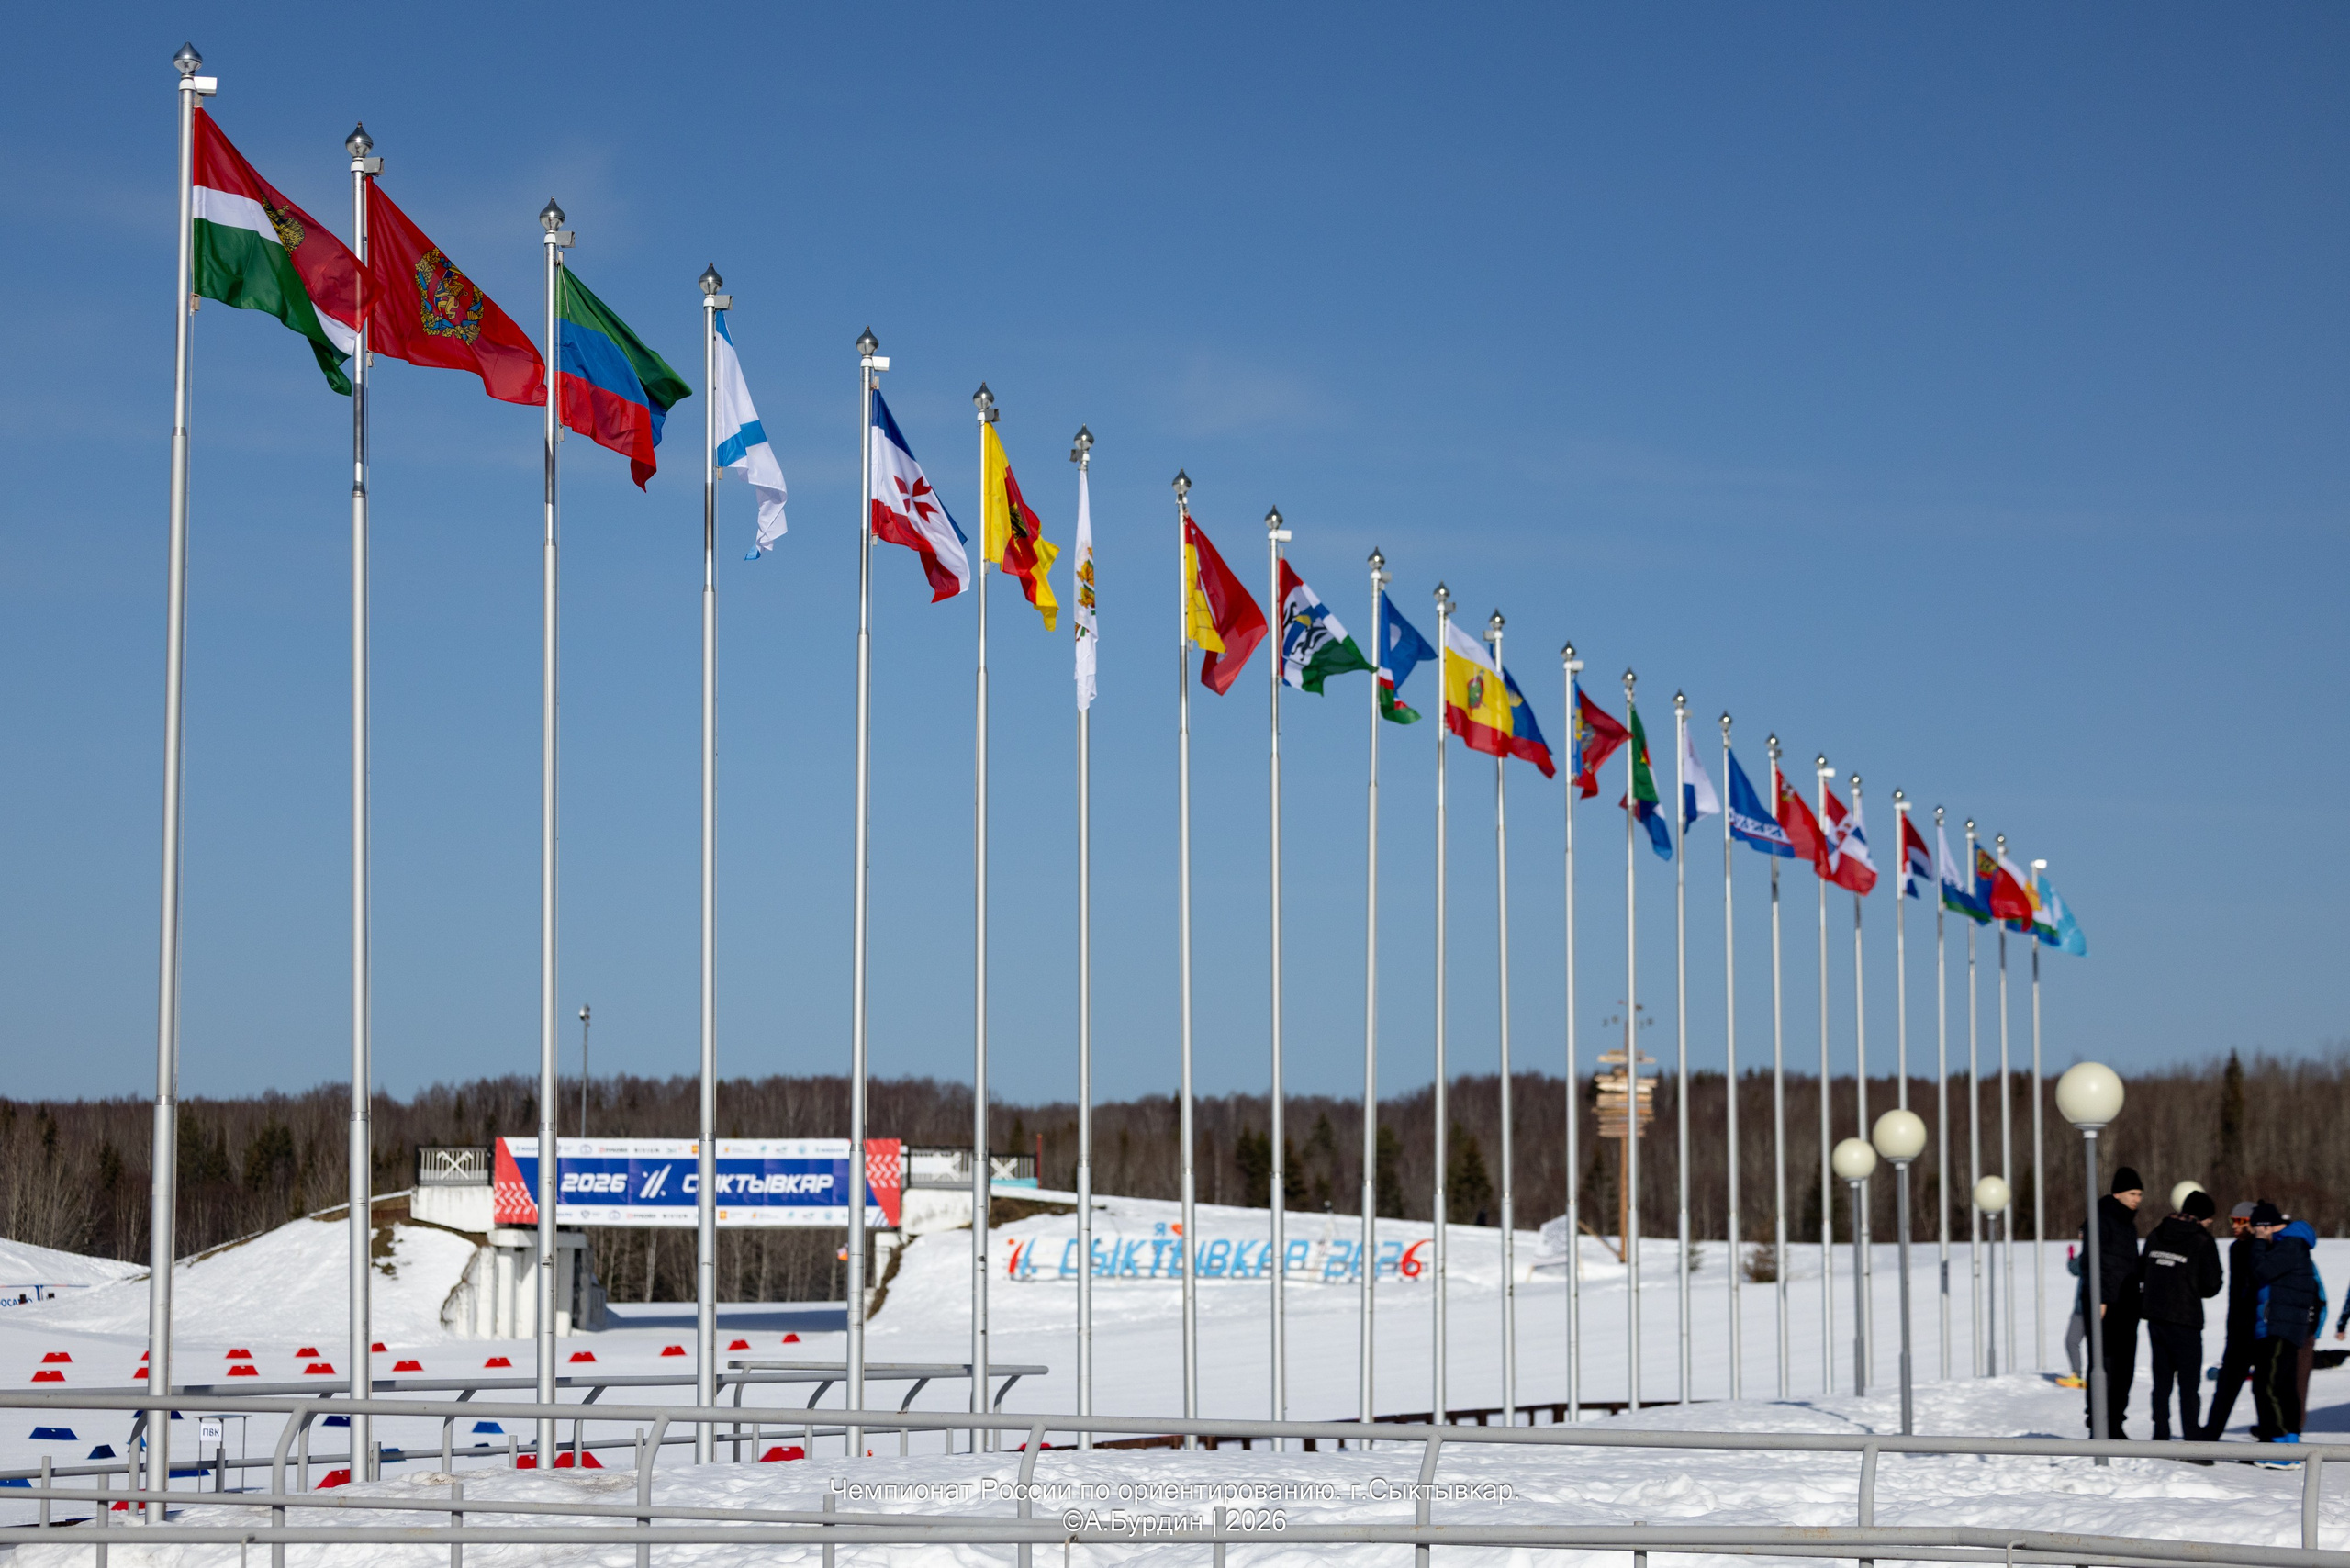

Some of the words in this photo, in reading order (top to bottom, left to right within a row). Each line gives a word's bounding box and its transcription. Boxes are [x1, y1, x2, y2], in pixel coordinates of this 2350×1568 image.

[560, 1173, 628, 1193] 2026
[682, 1173, 834, 1193] СКТЫВКАР
[1154, 1223, 1167, 1237] Я
[202, 1428, 220, 1437] ПВК
